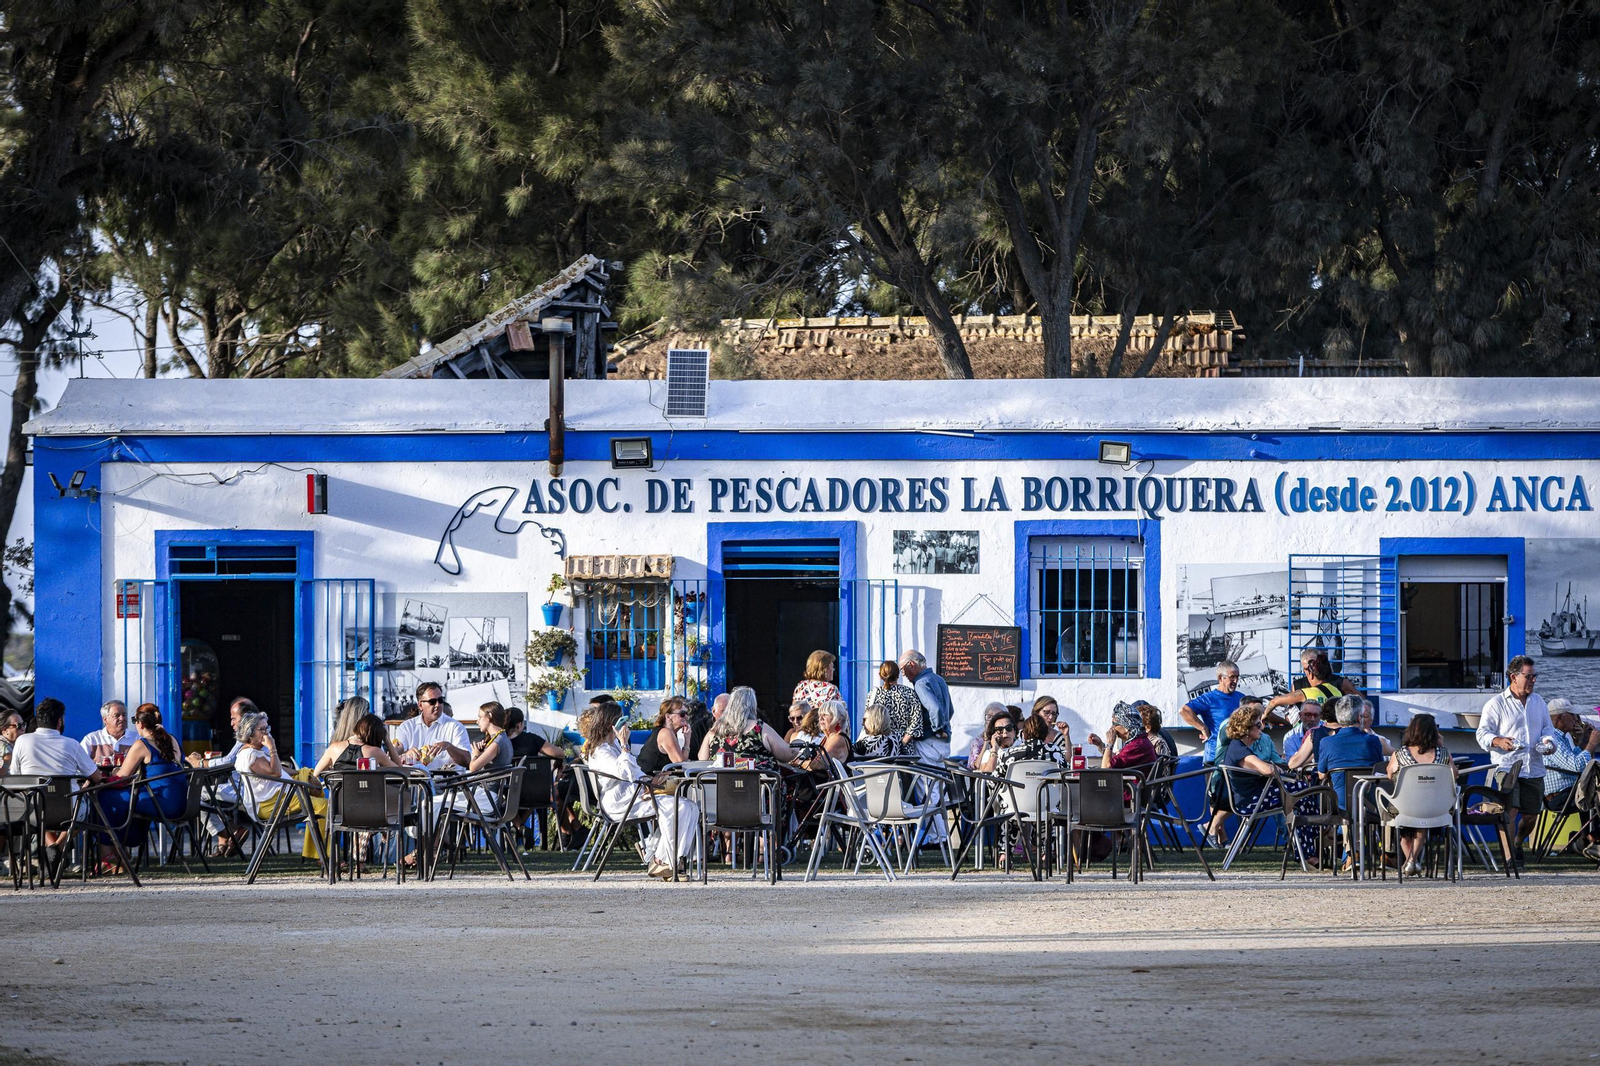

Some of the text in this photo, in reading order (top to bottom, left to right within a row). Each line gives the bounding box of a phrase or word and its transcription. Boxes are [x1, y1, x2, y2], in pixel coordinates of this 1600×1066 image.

[522, 471, 1592, 521] ASOC. DE PESCADORES LA BORRIQUERA (desde 2.012) ANCA
